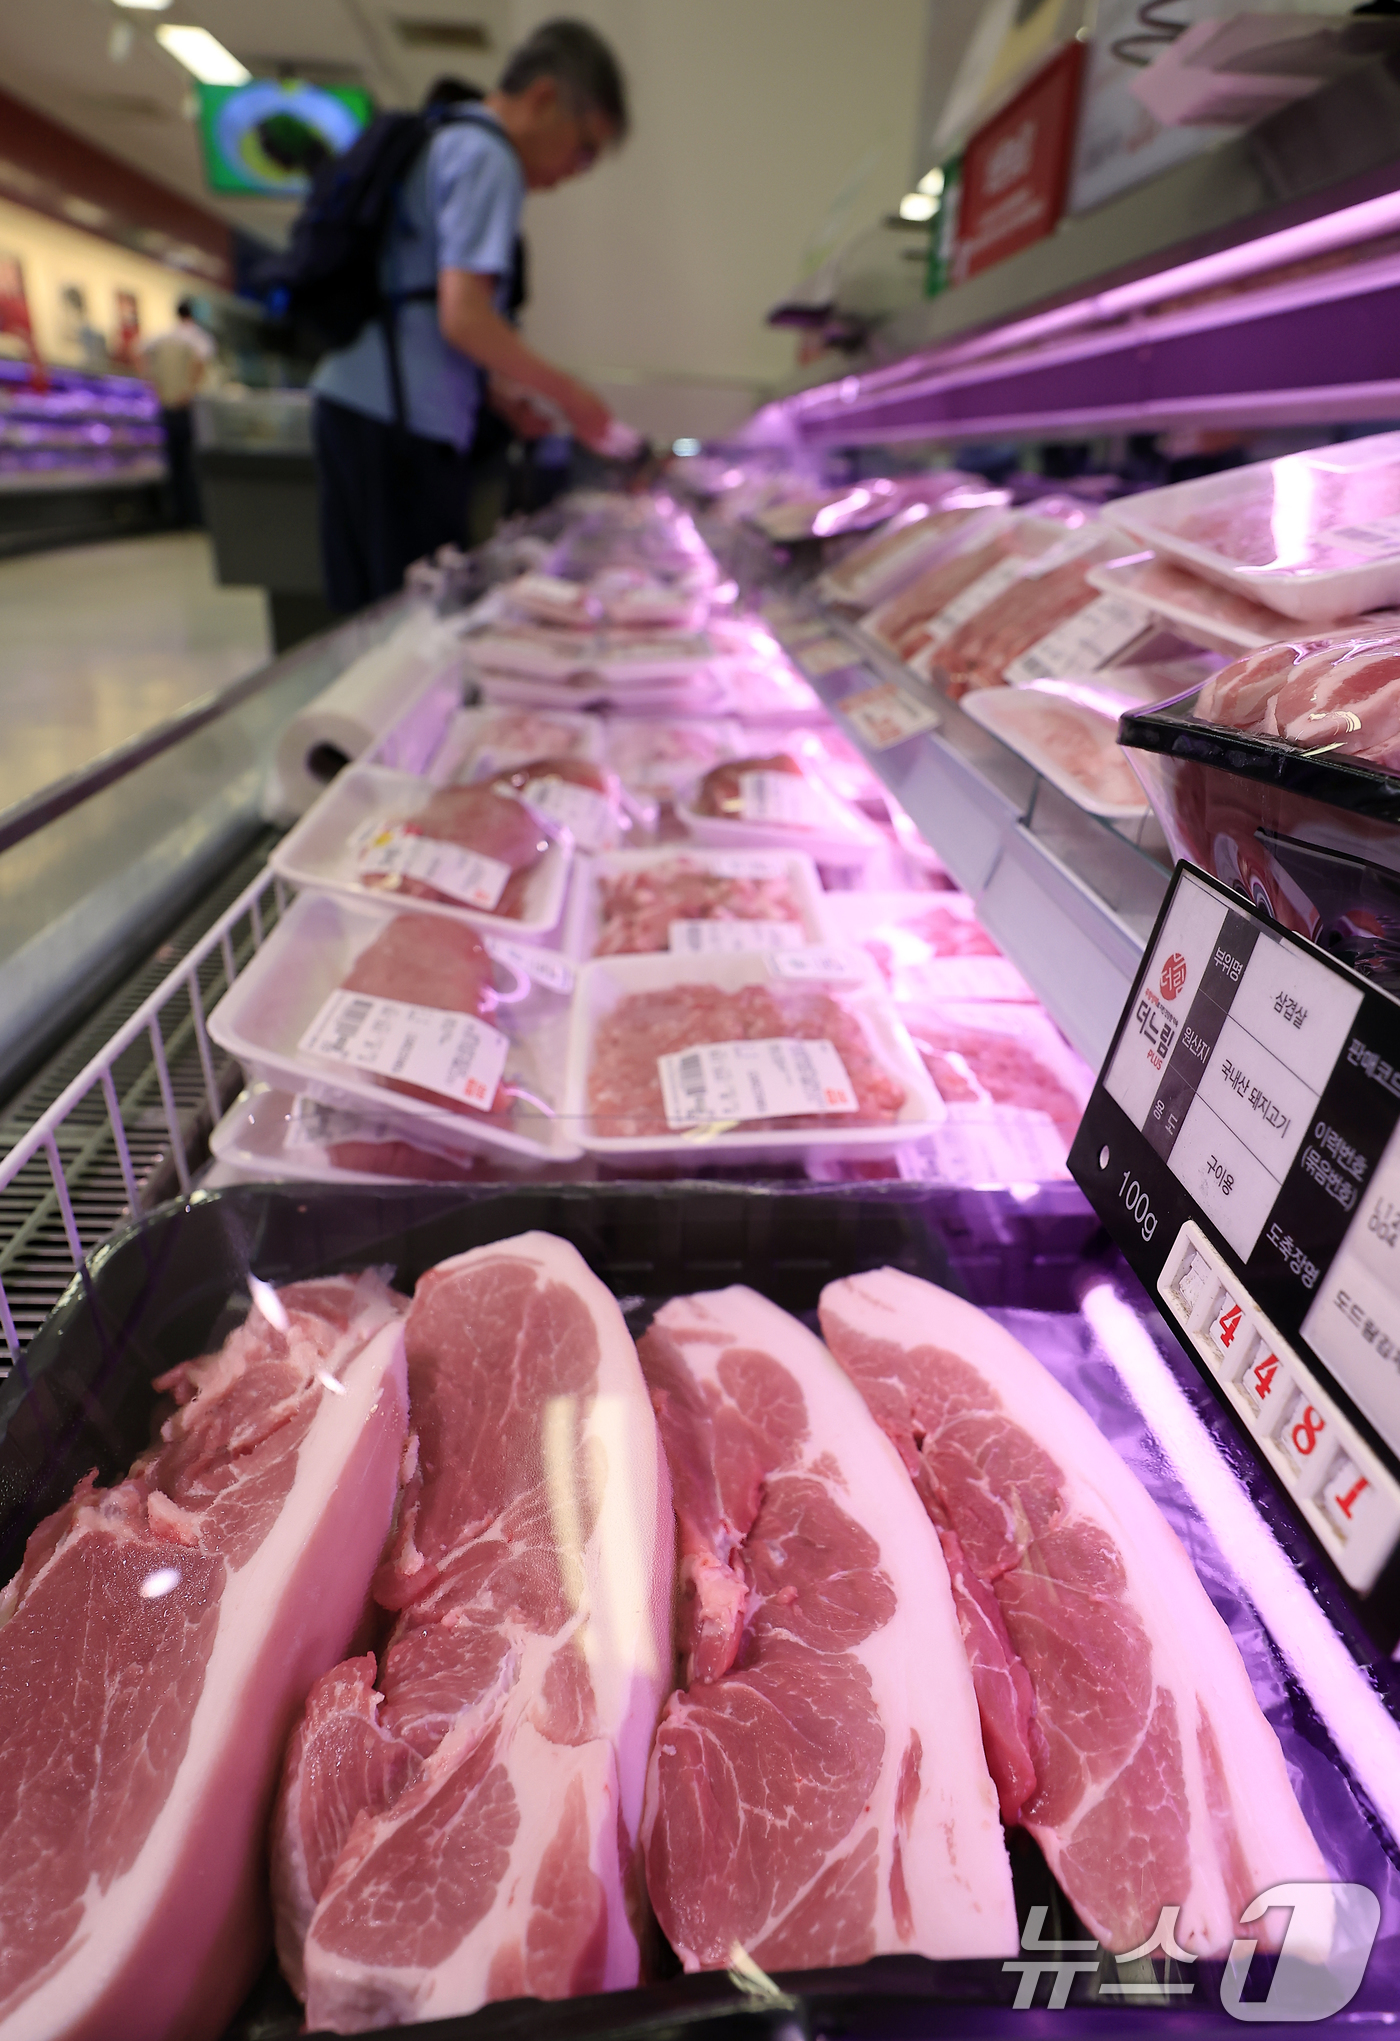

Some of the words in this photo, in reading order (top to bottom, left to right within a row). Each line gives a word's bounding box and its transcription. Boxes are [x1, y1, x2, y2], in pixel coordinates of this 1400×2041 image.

[1213, 946, 1244, 982] 부위명
[1136, 1000, 1175, 1059] 더느림
[1273, 990, 1308, 1030] 삼겹살
[1146, 1048, 1163, 1071] PLUS
[1182, 1026, 1211, 1064] 원산지
[1221, 1058, 1250, 1098] 국내산
[1248, 1087, 1292, 1139] 돼지고기
[1206, 1154, 1235, 1196] 구이용
[1301, 1145, 1358, 1212] (묶음번호)
[1314, 1121, 1368, 1182] 이력번호
[1118, 1170, 1158, 1242] 100g
[1266, 1222, 1321, 1289] 도축장명
